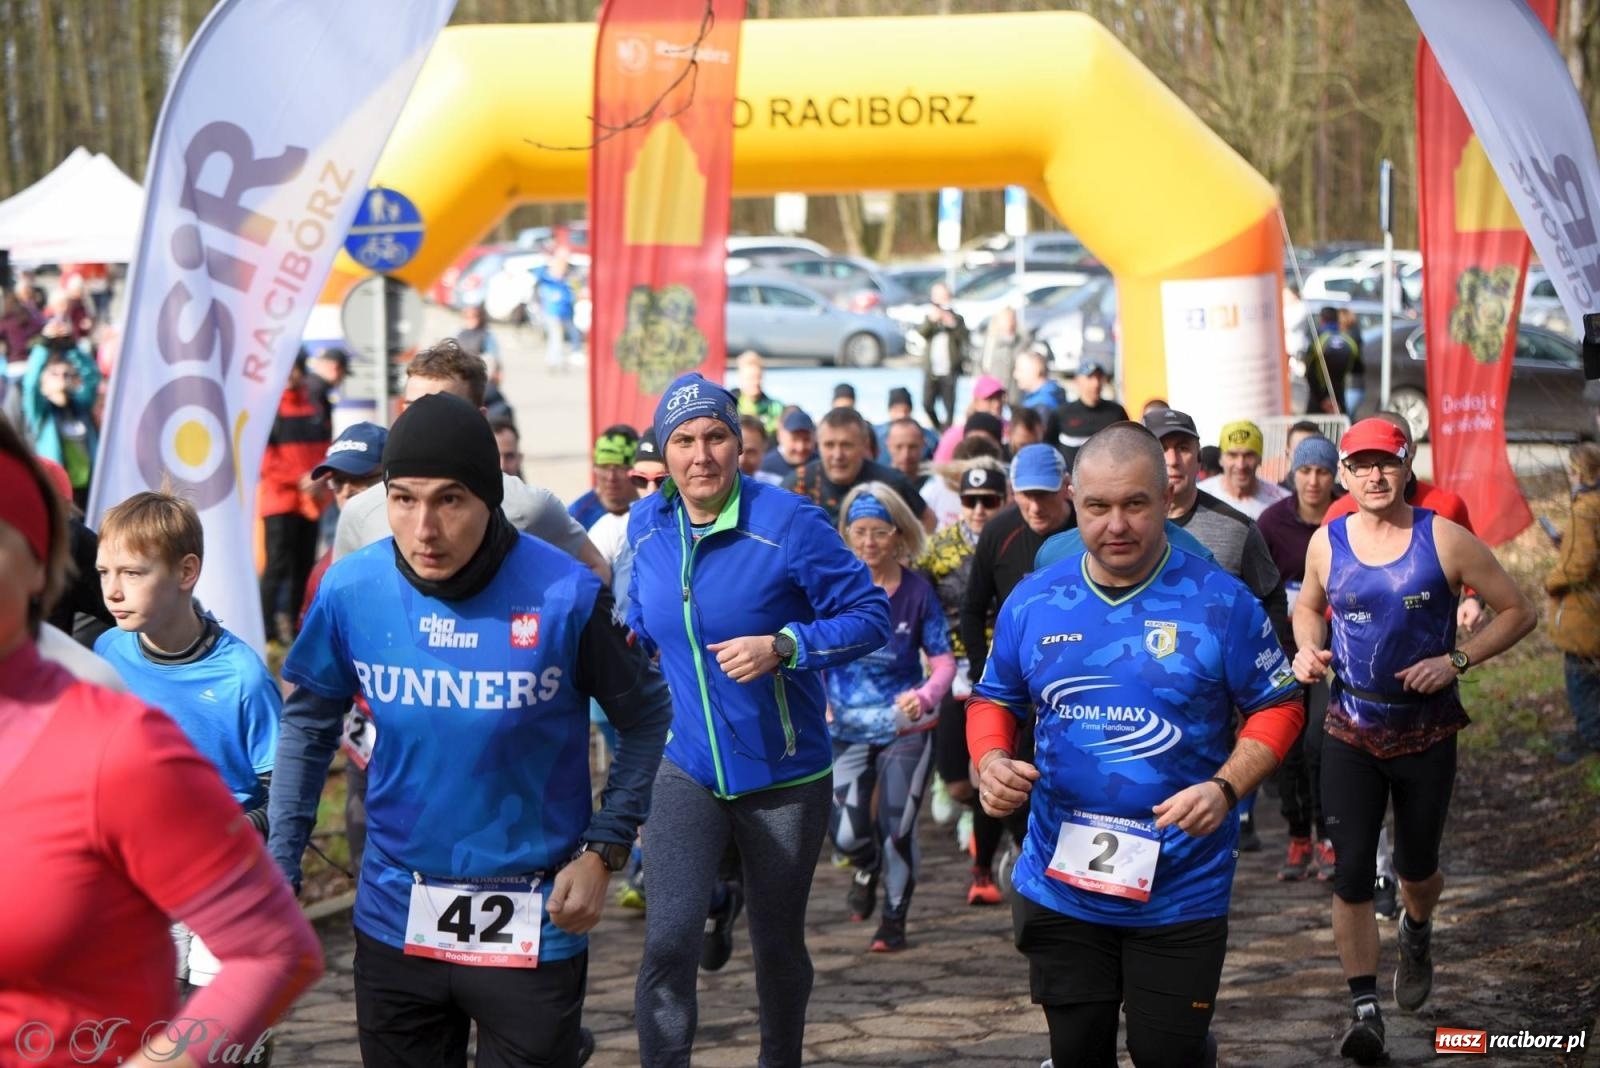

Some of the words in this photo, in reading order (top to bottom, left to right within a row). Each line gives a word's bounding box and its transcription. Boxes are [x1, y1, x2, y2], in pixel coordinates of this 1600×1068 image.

[769, 87, 978, 128] RACIBÓRZ
[242, 159, 355, 384] RACIBÓRZ
[353, 659, 562, 710] RUNNERS
[1058, 704, 1146, 722] ZŁOM-MAX
[1081, 722, 1100, 730] Firma
[1102, 723, 1136, 732] Handlowa
[1088, 832, 1119, 874] 2
[437, 895, 514, 944] 42
